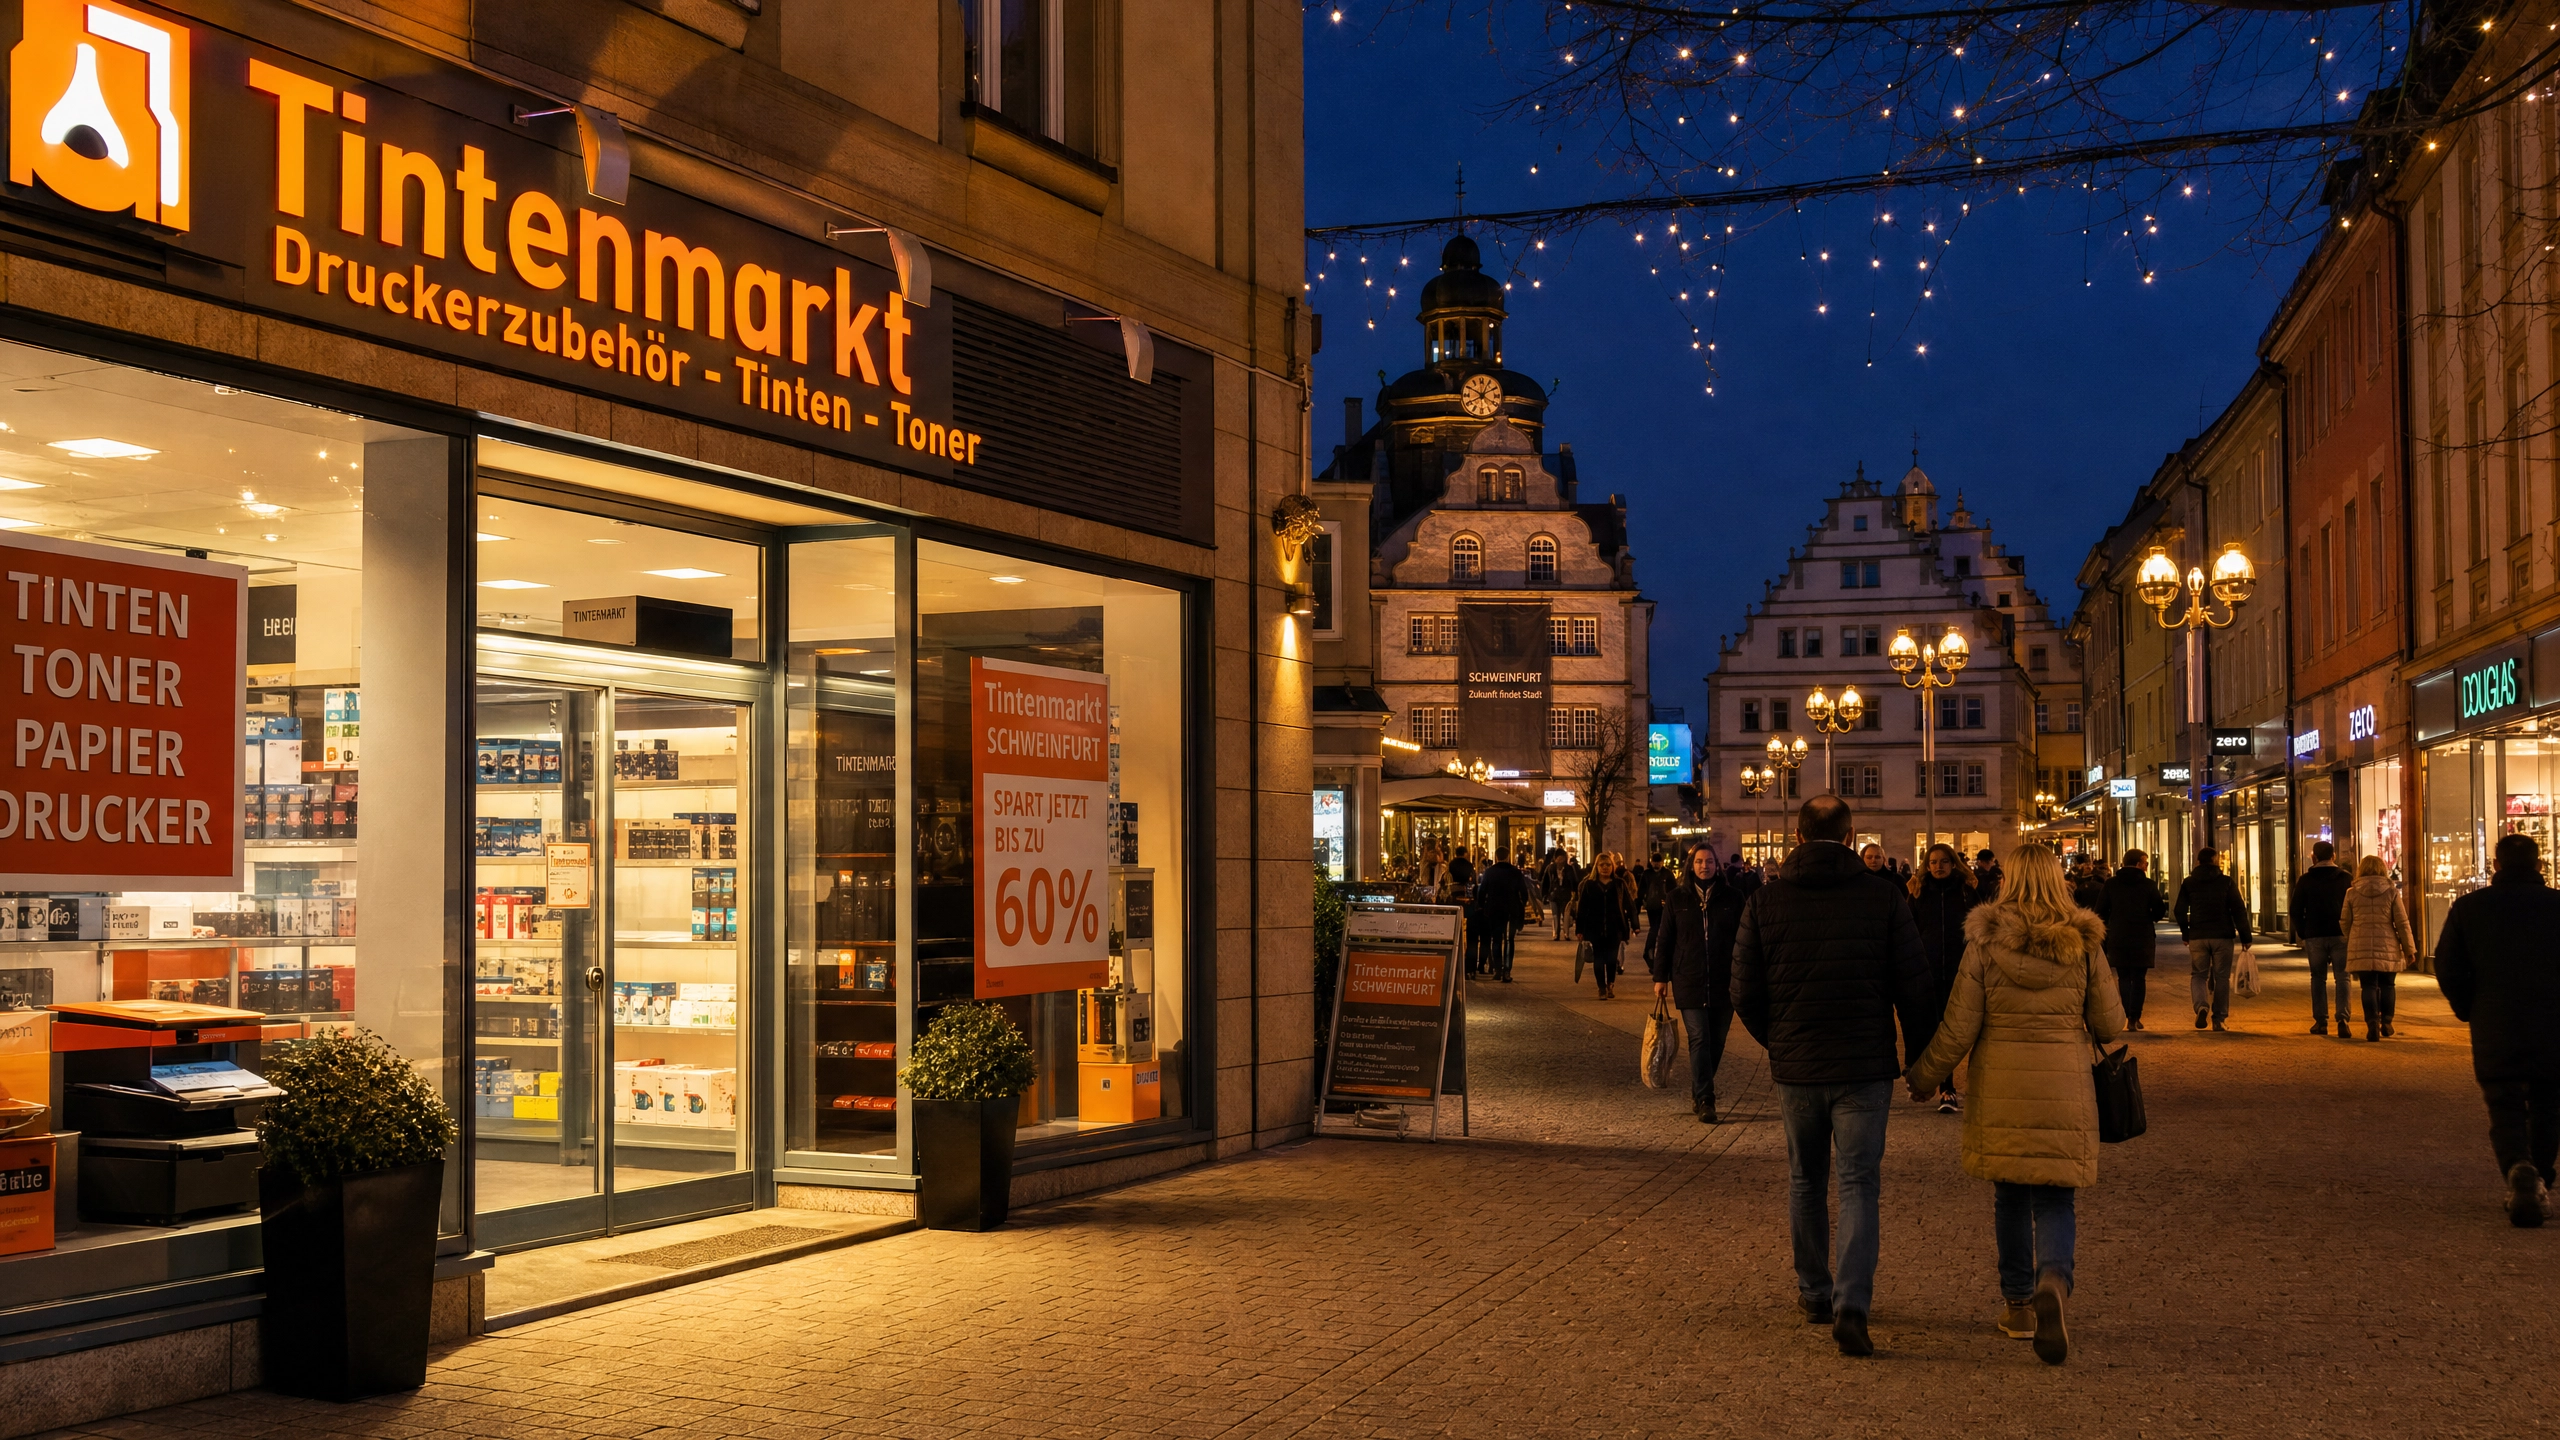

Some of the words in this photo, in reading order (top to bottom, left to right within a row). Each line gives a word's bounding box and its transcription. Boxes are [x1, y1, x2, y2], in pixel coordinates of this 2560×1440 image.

[247, 57, 912, 395] Tintenmarkt
[274, 225, 691, 387] Druckerzubehör
[735, 356, 851, 432] Tinten
[890, 400, 982, 465] Toner
[7, 570, 189, 639] TINTEN
[13, 643, 184, 708] TONER
[1468, 672, 1542, 683] SCHWEINFURT
[1468, 690, 1498, 699] Zukunft
[1499, 689, 1522, 699] findet
[1522, 690, 1543, 699] Stadt
[2462, 657, 2517, 719] DOUGLAS
[984, 681, 1103, 724] Tintenmarkt
[2349, 704, 2375, 741] zero
[15, 718, 186, 777] PAPIER
[987, 726, 1101, 762] SCHWEINFURT
[2216, 736, 2248, 747] zero
[0, 789, 213, 845] DRUCKER
[994, 789, 1044, 817] SPART
[1046, 793, 1089, 824] JETZT
[995, 827, 1020, 853] BIS
[1024, 828, 1044, 853] ZU
[995, 867, 1099, 947] 60%
[1352, 980, 1436, 995] SCHWEINFURT
[1354, 963, 1437, 980] Tintenmarkt
